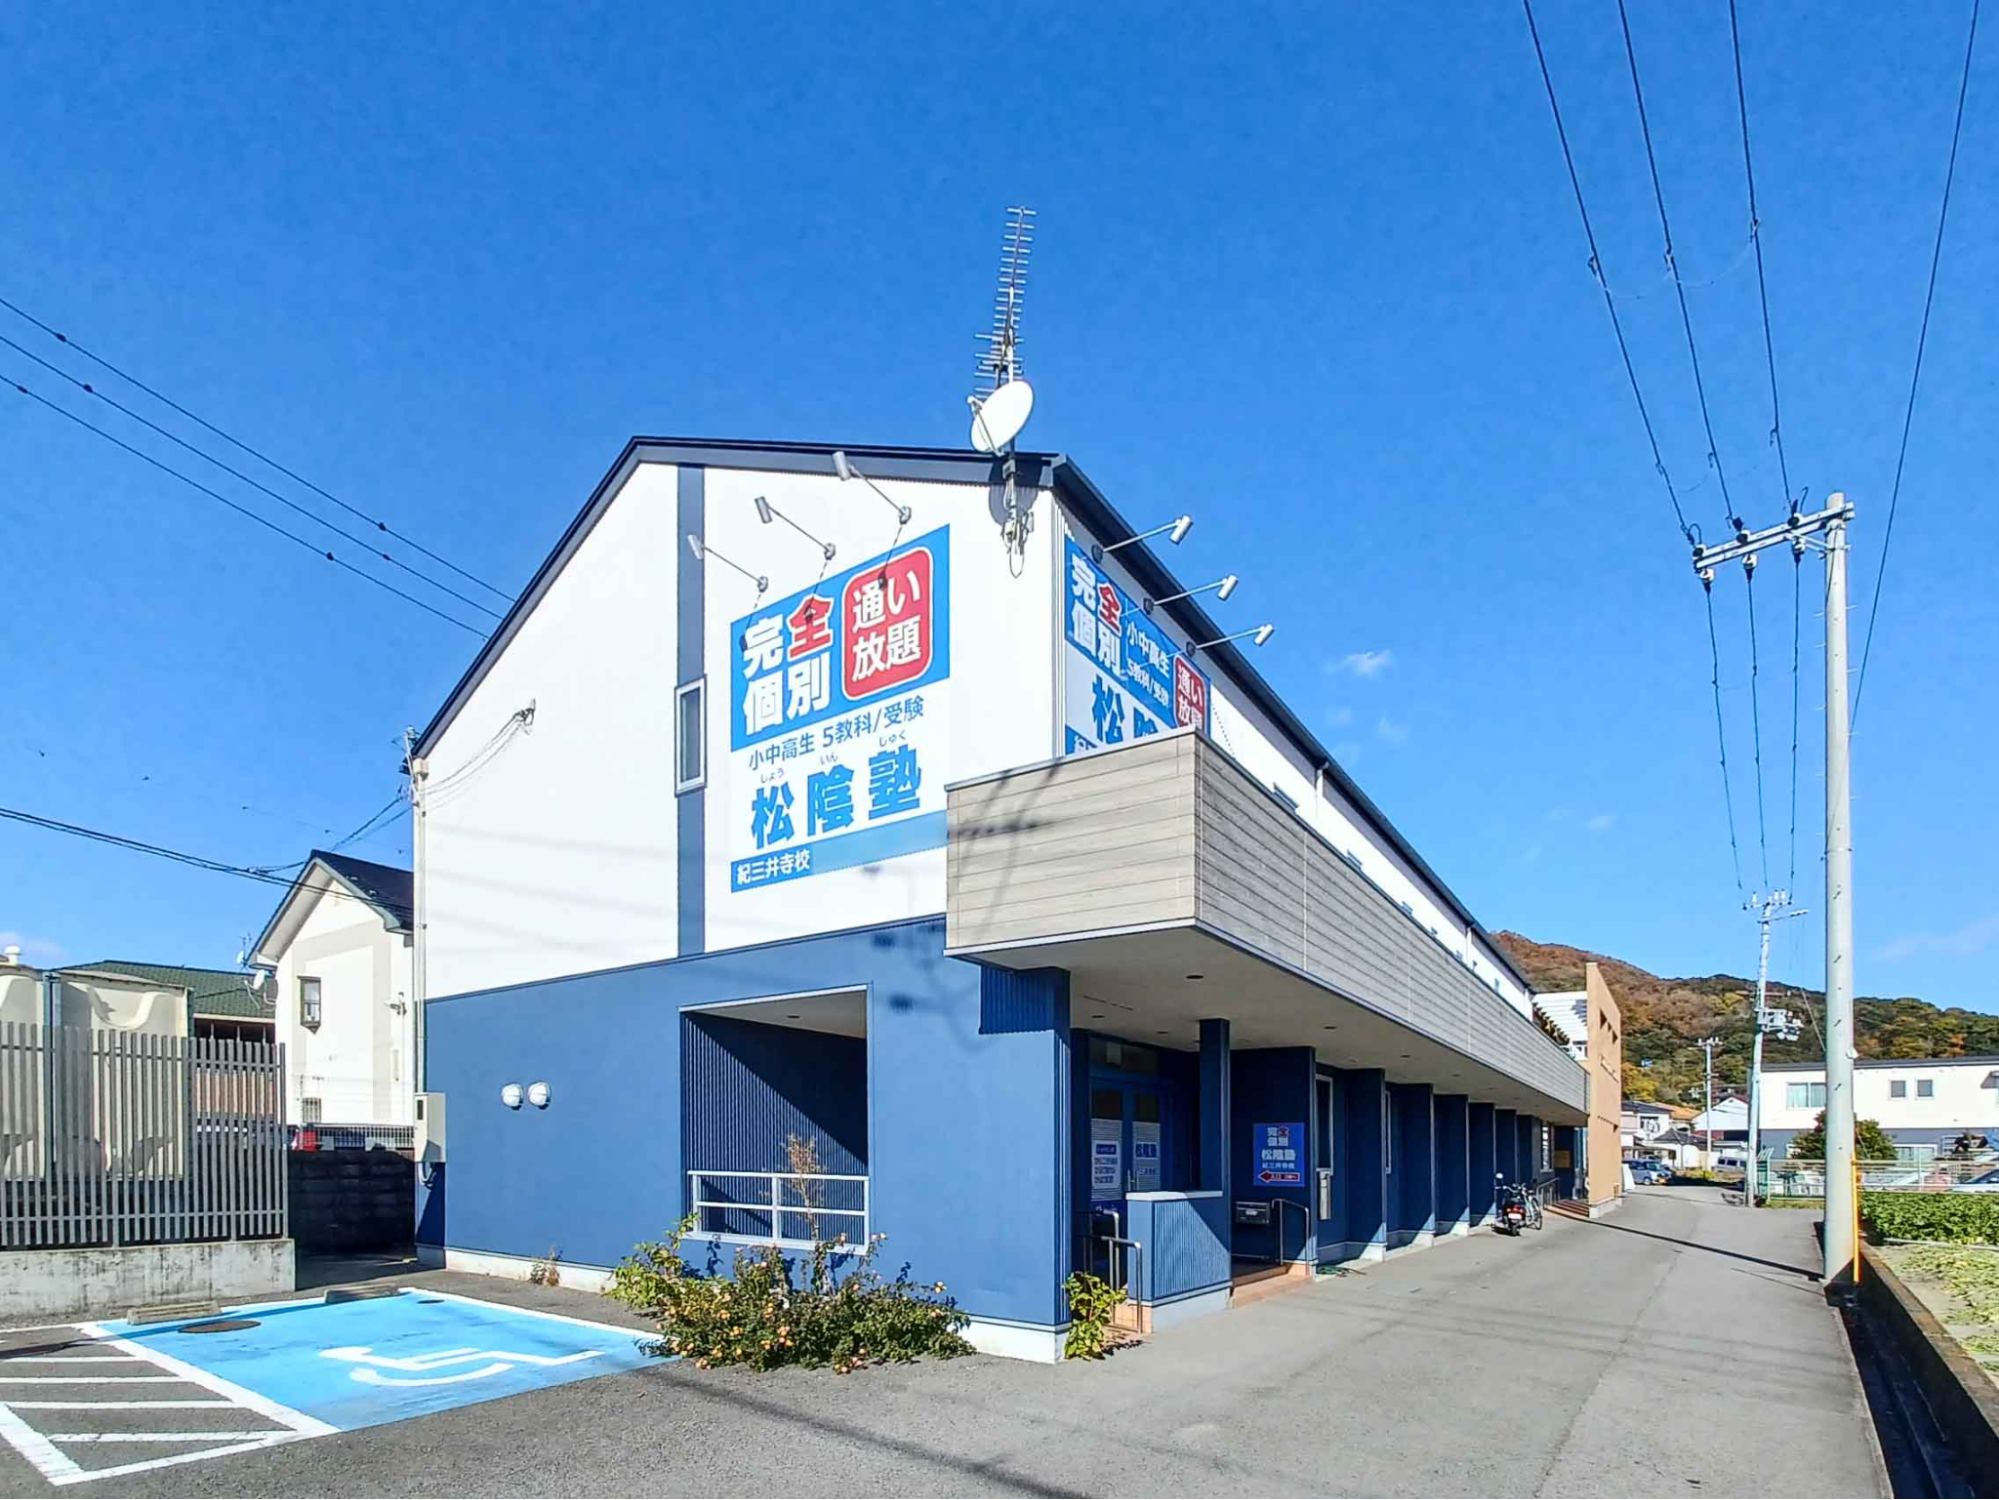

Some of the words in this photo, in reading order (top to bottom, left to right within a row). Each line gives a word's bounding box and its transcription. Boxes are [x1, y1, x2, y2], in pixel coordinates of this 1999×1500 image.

[852, 570, 921, 634] 通い
[1071, 553, 1122, 636] 完全
[743, 594, 834, 679] 完全
[851, 615, 921, 683] 放題
[1071, 599, 1127, 679] 個別
[1126, 621, 1171, 678] 小中高生
[742, 651, 831, 736] 個別
[1177, 665, 1203, 707] 通い
[748, 731, 816, 773] 小中高生
[822, 694, 925, 749] 5教科/受験
[751, 744, 922, 850] 松陰塾
[737, 848, 811, 886] 紀三井寺校
